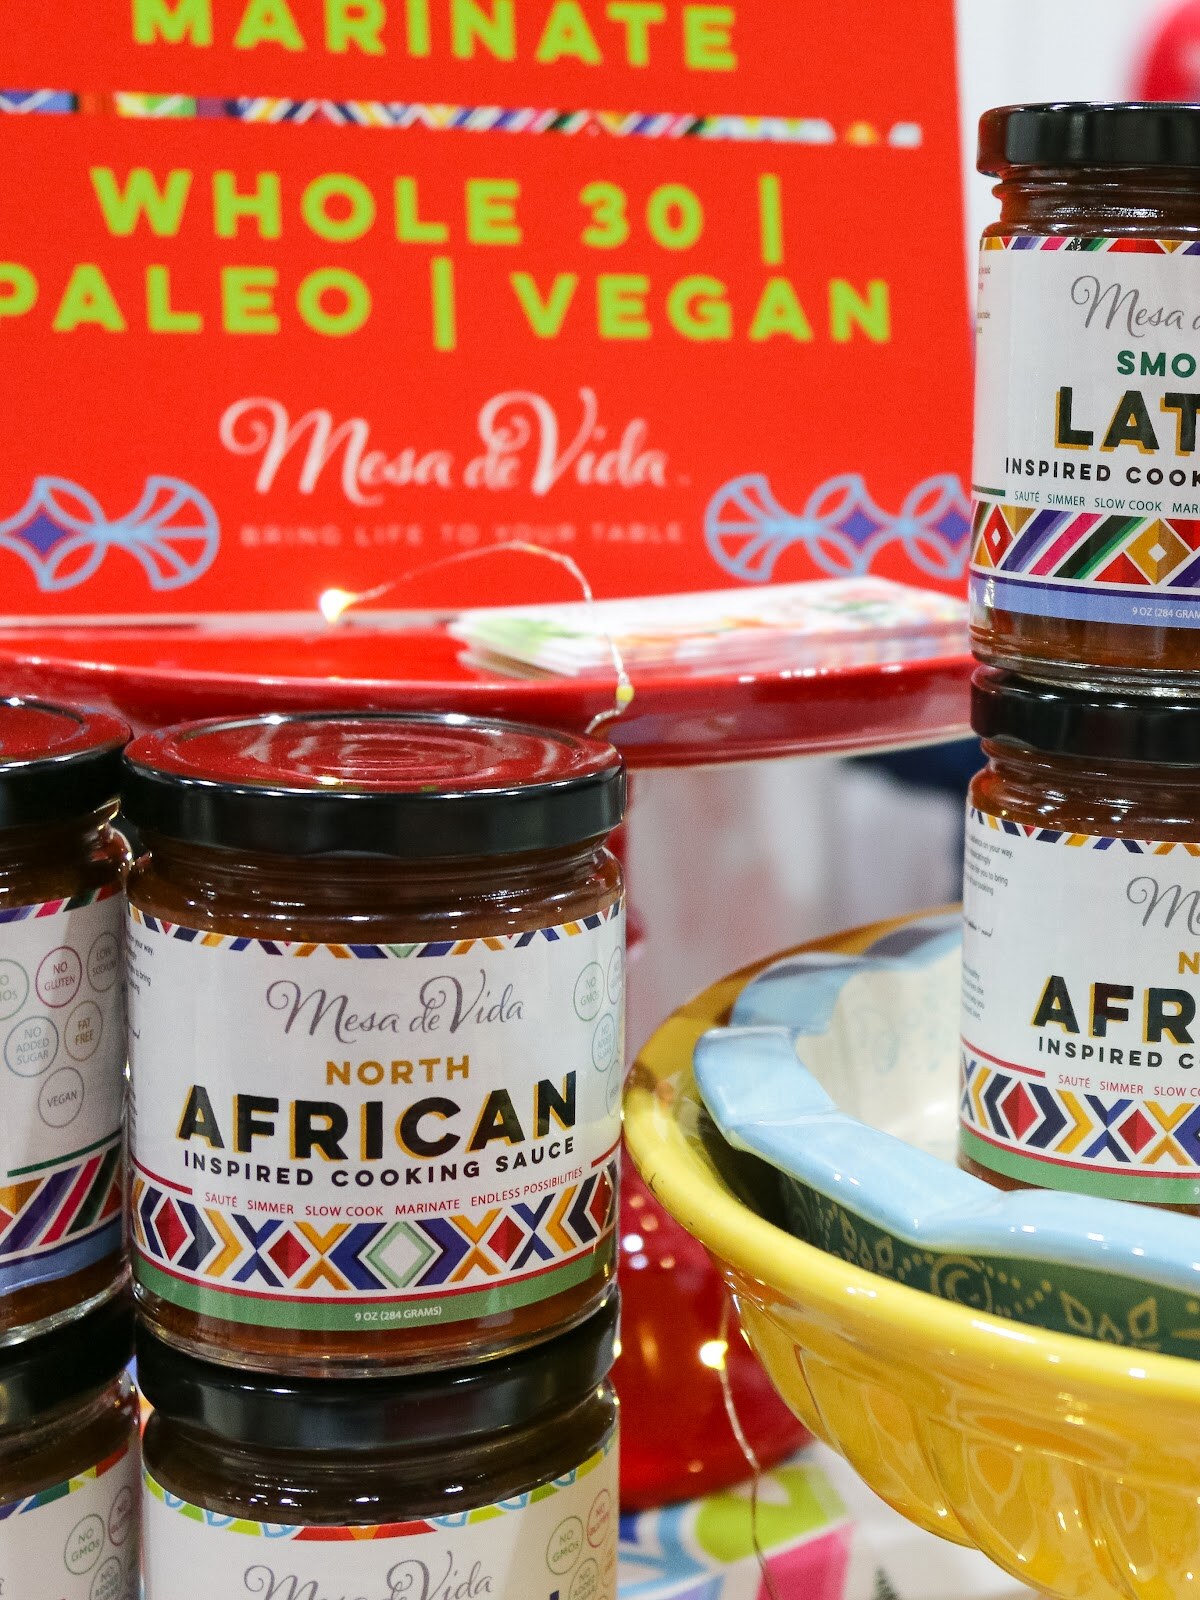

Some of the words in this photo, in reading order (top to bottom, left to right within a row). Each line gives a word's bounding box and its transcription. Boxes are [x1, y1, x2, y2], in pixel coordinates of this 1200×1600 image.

[132, 0, 737, 70] MARINATE
[90, 165, 522, 246] WHOLE
[579, 182, 704, 250] 30
[0, 263, 373, 336] PALEO
[511, 272, 891, 342] VEGAN
[1070, 275, 1184, 338] Mesa
[218, 396, 454, 506] Mesa
[478, 386, 668, 496] Vida
[463, 427, 521, 491] de
[1005, 457, 1112, 482] INSPIRED
[1014, 490, 1040, 503] SAUTÉ
[1047, 493, 1086, 507] SIMMER
[1095, 497, 1125, 510] SLOW
[1129, 499, 1162, 512] COOK
[1132, 607, 1138, 615] 9
[1140, 608, 1152, 616] OZ
[1155, 608, 1173, 617] (284
[54, 961, 68, 974] NO
[45, 976, 75, 991] GLUTEN
[586, 977, 596, 987] NO
[265, 979, 399, 1044] Mesa
[419, 969, 523, 1035] Vida
[78, 1018, 90, 1030] FAT
[409, 1000, 440, 1033] de
[25, 1027, 41, 1039] NO
[75, 1033, 94, 1045] FREE
[17, 1039, 50, 1053] ADDED
[1038, 1036, 1163, 1068] INSPIRED
[17, 1051, 48, 1065] SUGAR
[326, 1055, 469, 1086] NORTH
[1058, 1074, 1090, 1089] SAUTÉ
[1100, 1081, 1144, 1094] SIMMER
[1154, 1086, 1186, 1096] SLOW
[47, 1090, 77, 1108] VEGAN
[175, 1071, 577, 1163] AFRICAN
[184, 1150, 314, 1186] INSPIRED
[332, 1161, 480, 1187] COOKING
[495, 1136, 574, 1172] SAUCE
[205, 1191, 238, 1207] SAUTÉ
[247, 1199, 294, 1214] SIMMER
[305, 1205, 343, 1217] SLOW
[346, 1206, 384, 1216] COOK
[395, 1199, 460, 1215] MARINATE
[471, 1188, 521, 1207] ENDLESS
[523, 1166, 583, 1195] POSSIBILITIES
[1194, 1187, 1200, 1195] 9
[355, 1312, 361, 1321] 9
[364, 1312, 378, 1320] OZ
[380, 1311, 401, 1320] (284
[404, 1306, 442, 1319] GRAMS)
[79, 1528, 94, 1544] NO
[560, 1530, 574, 1542] NO
[71, 1539, 101, 1562] GMOs
[552, 1541, 580, 1562] GMOs
